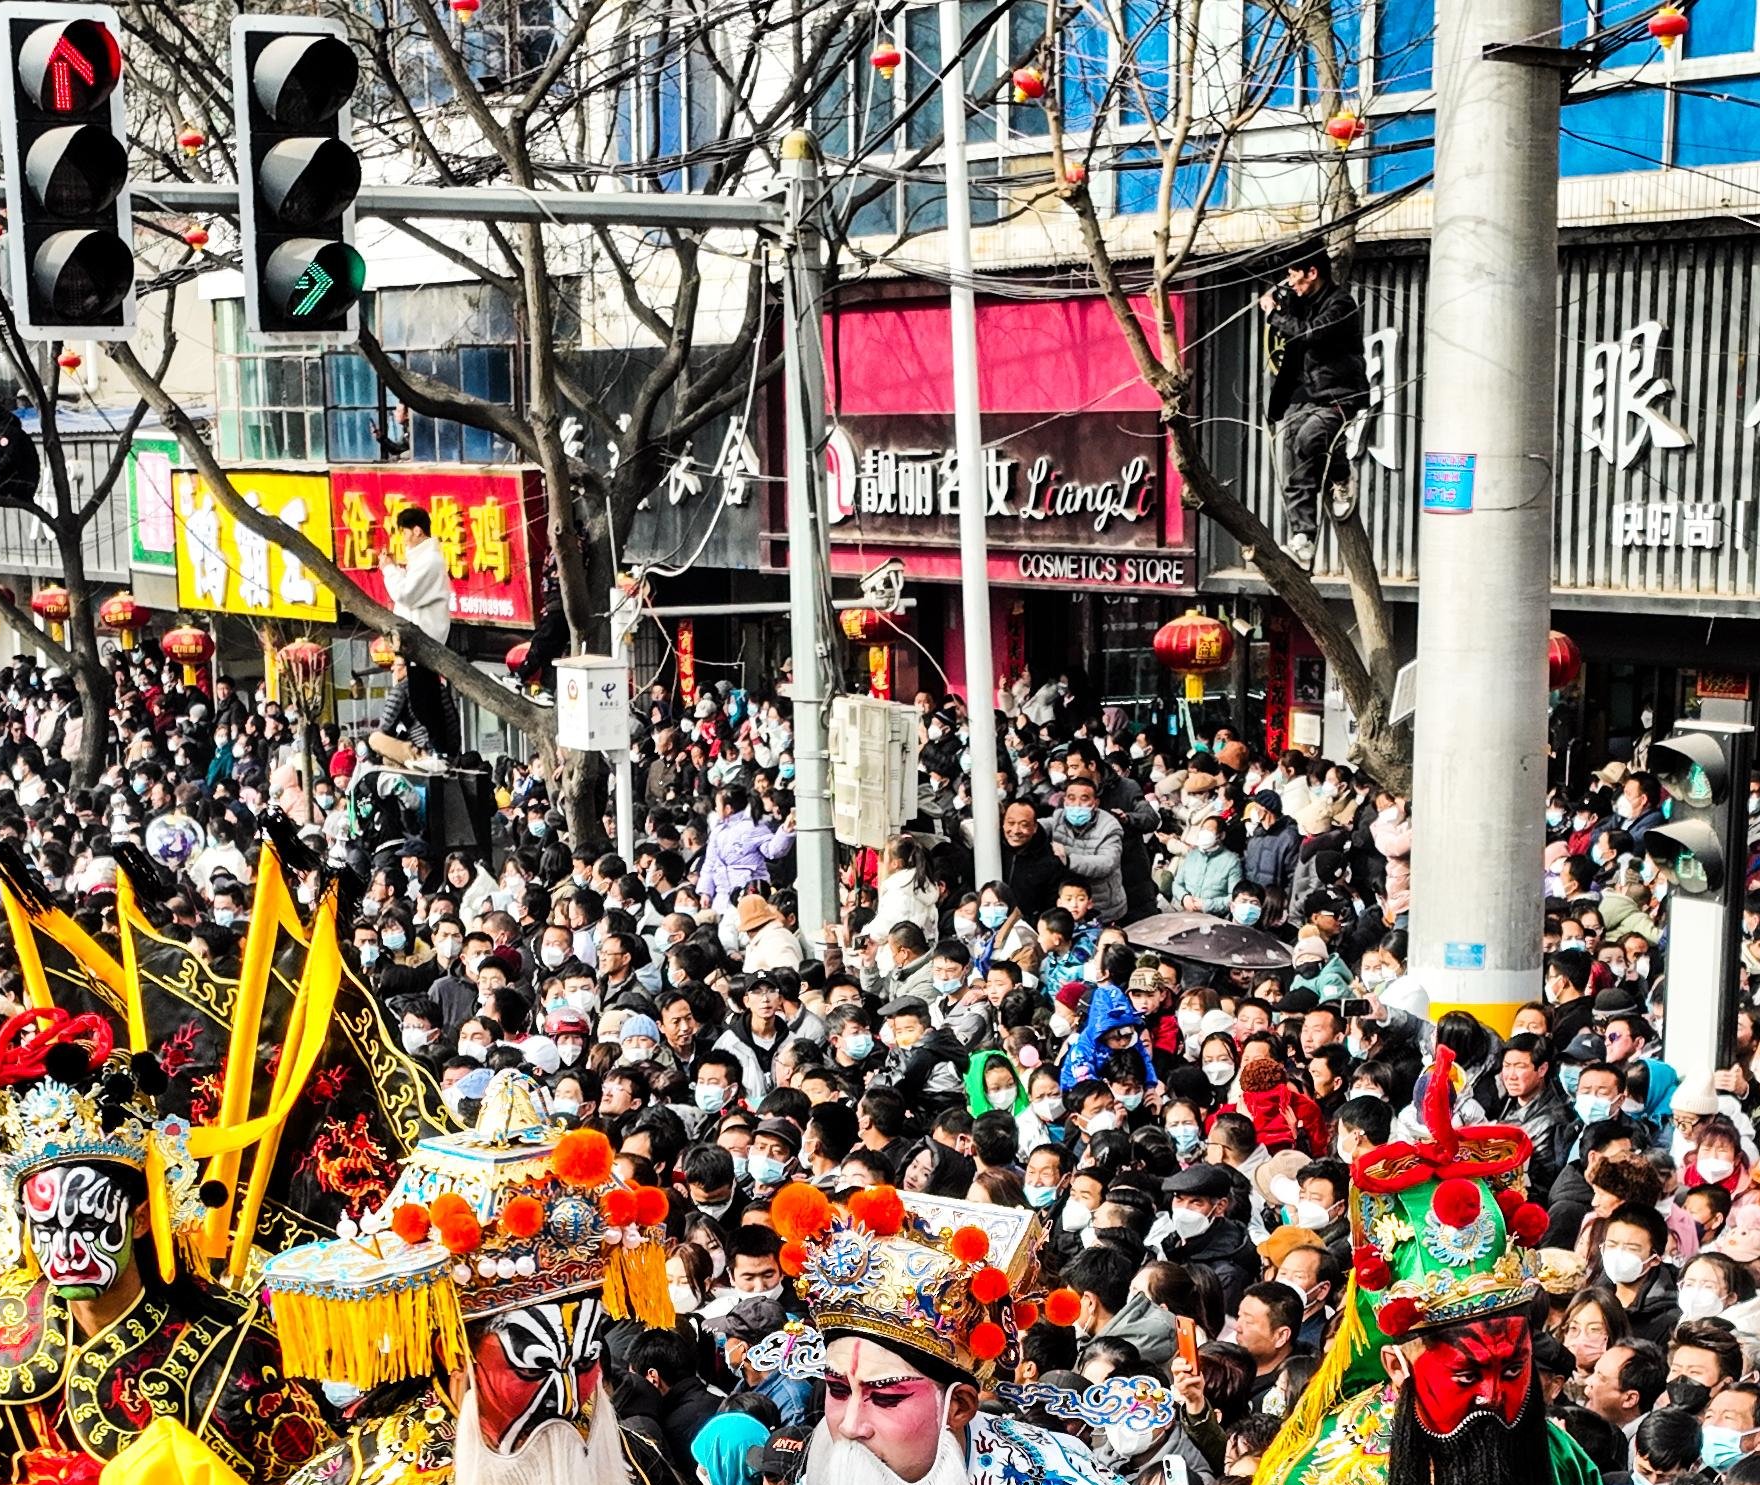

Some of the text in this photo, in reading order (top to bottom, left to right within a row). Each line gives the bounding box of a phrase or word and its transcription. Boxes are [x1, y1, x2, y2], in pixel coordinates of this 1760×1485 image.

[1019, 553, 1184, 584] COSMETICS STORE
[772, 1437, 803, 1452] ANTA
